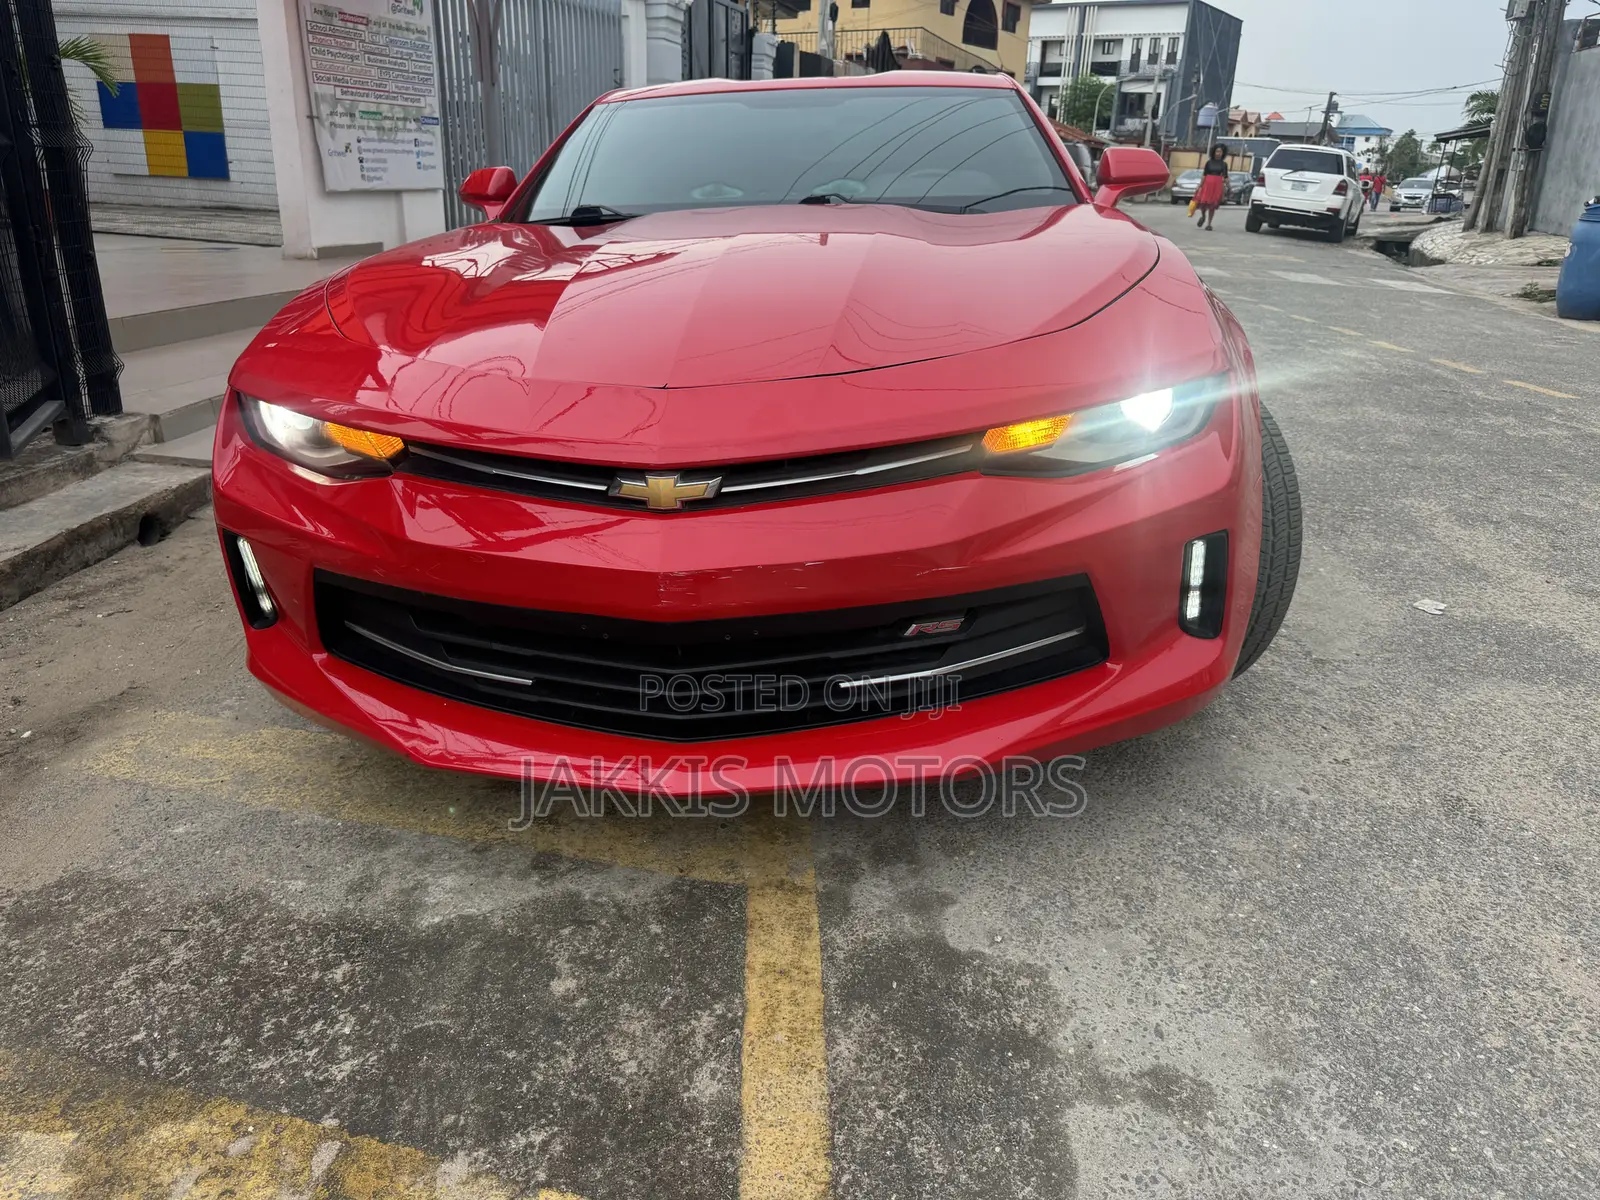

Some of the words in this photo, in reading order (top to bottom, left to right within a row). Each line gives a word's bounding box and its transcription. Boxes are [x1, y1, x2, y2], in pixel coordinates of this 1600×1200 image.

[324, 10, 333, 18] You
[396, 24, 414, 34] following
[310, 24, 327, 32] School
[329, 26, 363, 38] Administrator
[312, 36, 332, 46] Phonics
[333, 40, 353, 48] Teacher
[385, 36, 409, 46] Classroom
[410, 40, 430, 49] Educator
[312, 47, 326, 56] Child
[327, 50, 360, 62] Psychologist
[362, 44, 388, 54] Accountant
[394, 48, 414, 58] Language
[415, 52, 432, 60] Teacher
[316, 61, 345, 70] Educational
[347, 66, 373, 76] Consultant
[367, 56, 387, 65] Business
[388, 58, 406, 68] Analysts
[413, 63, 431, 71] Scientist
[315, 74, 331, 82] Social
[332, 76, 348, 84] Media
[350, 78, 369, 87] Content
[370, 81, 388, 89] Creator
[392, 72, 416, 80] Curriculum
[417, 75, 432, 84] Expert
[341, 88, 370, 98] Behavioural
[373, 92, 399, 101] Specialized
[400, 95, 422, 104] Therapist
[412, 86, 432, 94] Resource
[905, 618, 964, 636] RS
